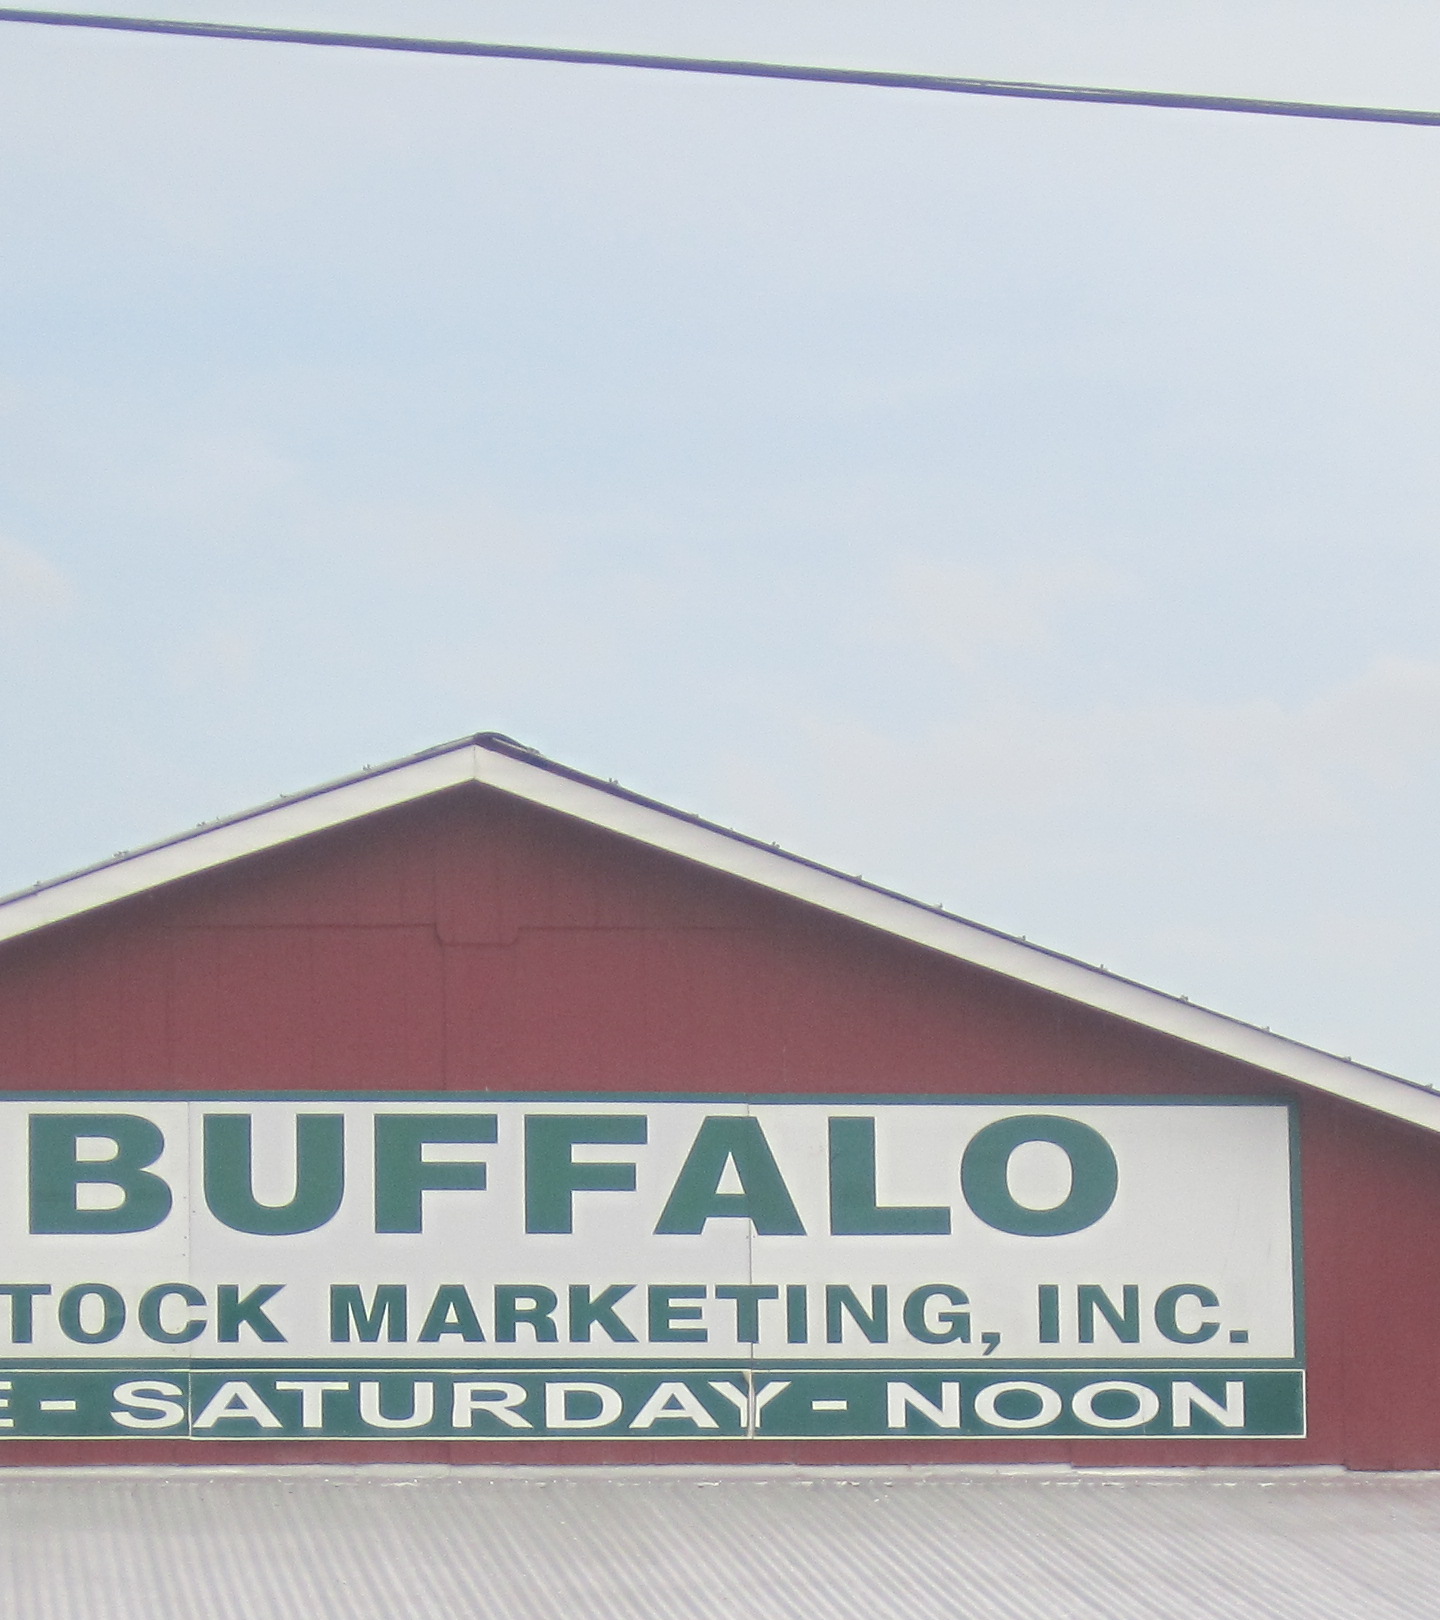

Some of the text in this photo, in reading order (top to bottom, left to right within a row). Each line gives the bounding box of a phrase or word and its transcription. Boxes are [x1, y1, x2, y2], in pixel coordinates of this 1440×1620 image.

[28, 1113, 1118, 1237] BUFFALO
[329, 1284, 1001, 1355] MARKETING,
[1037, 1284, 1250, 1344] INC.
[109, 1381, 791, 1430] SATURDAY
[885, 1381, 1246, 1429] NOON
